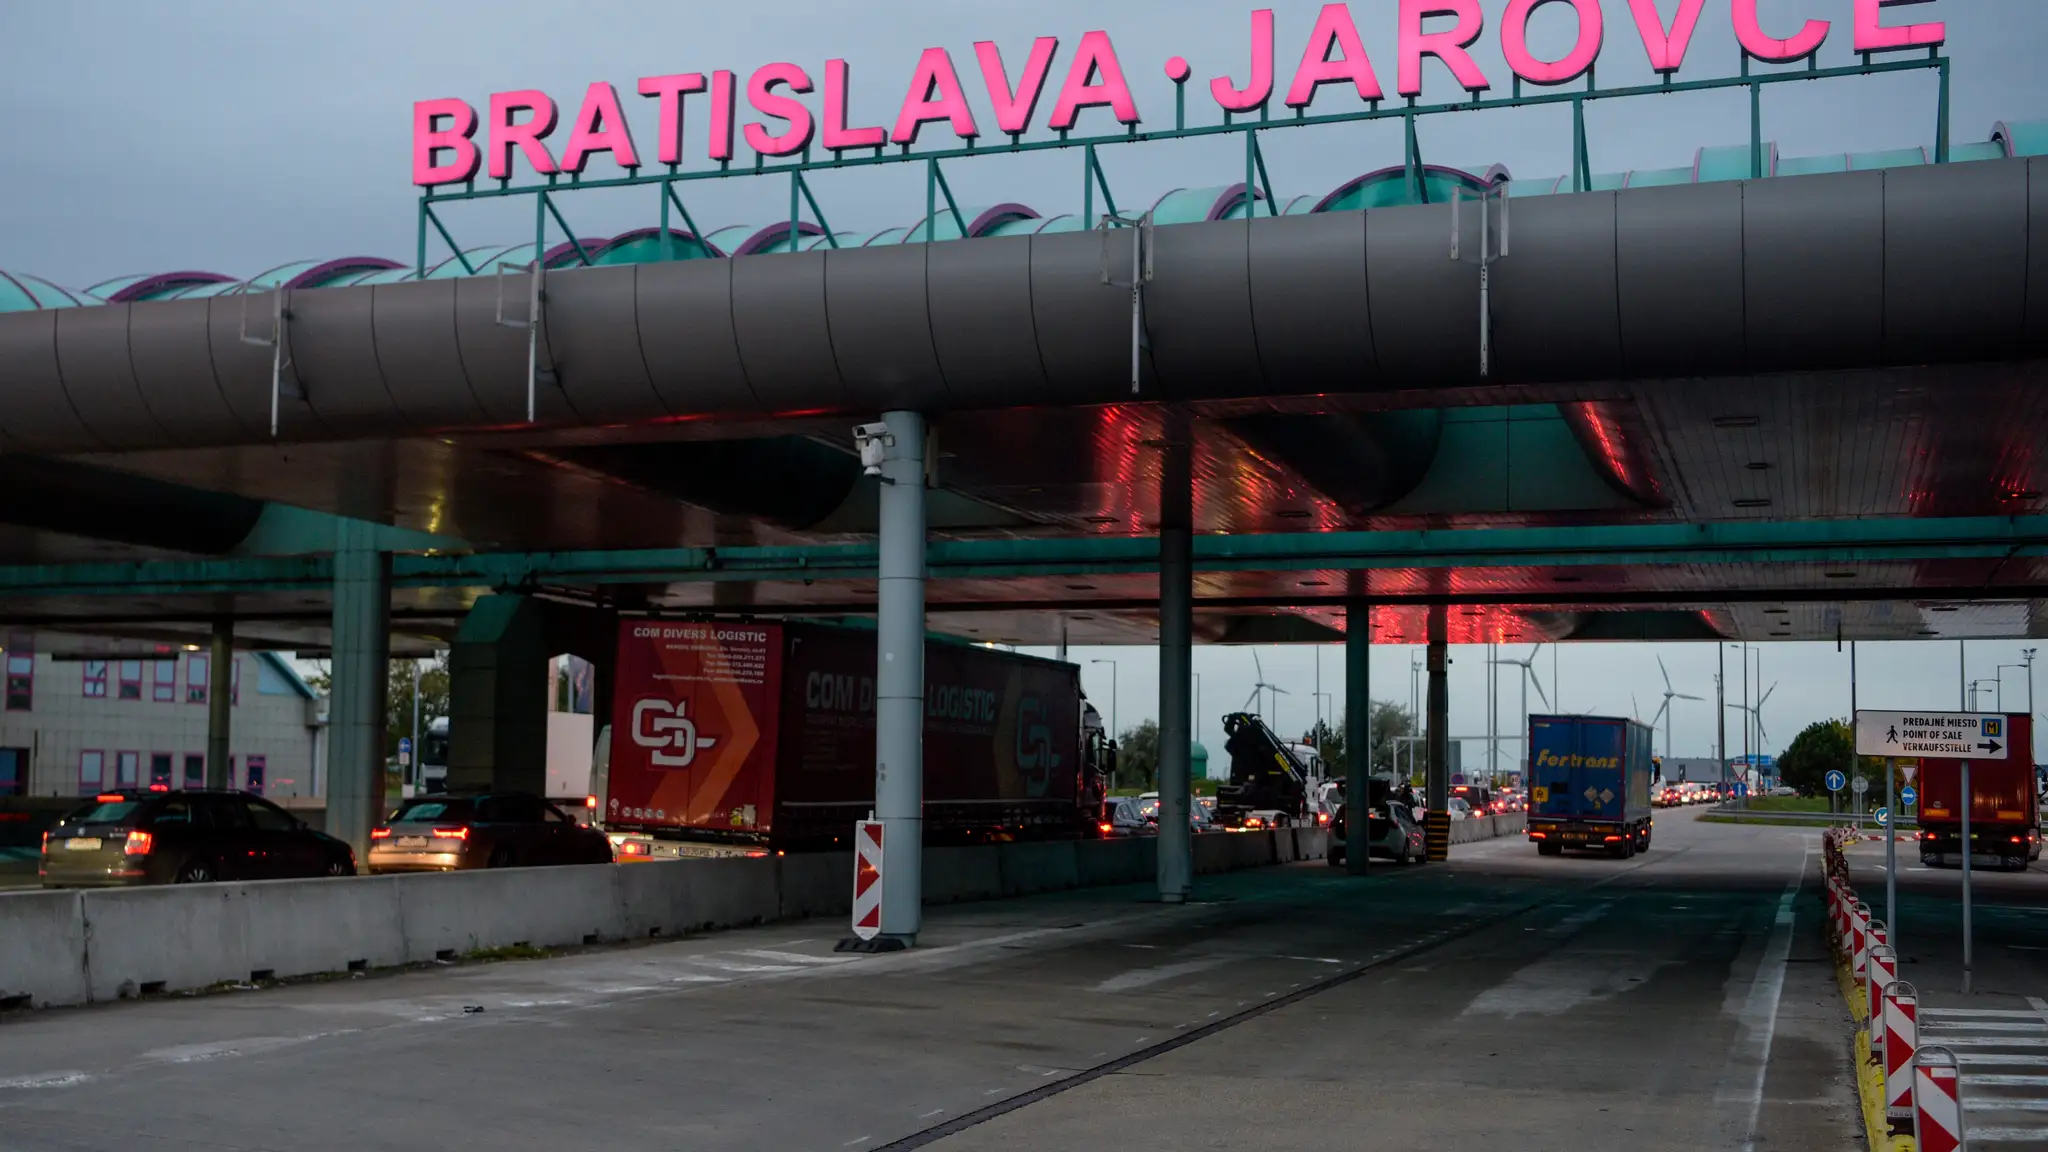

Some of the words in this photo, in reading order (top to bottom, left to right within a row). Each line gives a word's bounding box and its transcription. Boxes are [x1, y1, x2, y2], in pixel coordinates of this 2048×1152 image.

[414, 31, 1139, 185] BRATISLAVA
[634, 627, 660, 638] COM
[663, 628, 707, 640] DIVERS
[710, 630, 767, 643] LOGISTIC
[806, 670, 854, 711] COM
[927, 684, 995, 721] LOGISTIC
[1903, 716, 1945, 727] PREDAJNÉ
[1947, 718, 1978, 728] MIESTO
[1903, 730, 1927, 739] POINT
[1929, 730, 1940, 739] OF
[1942, 731, 1962, 740] SALE
[1903, 742, 1972, 753] VERKAUFSSTELLE
